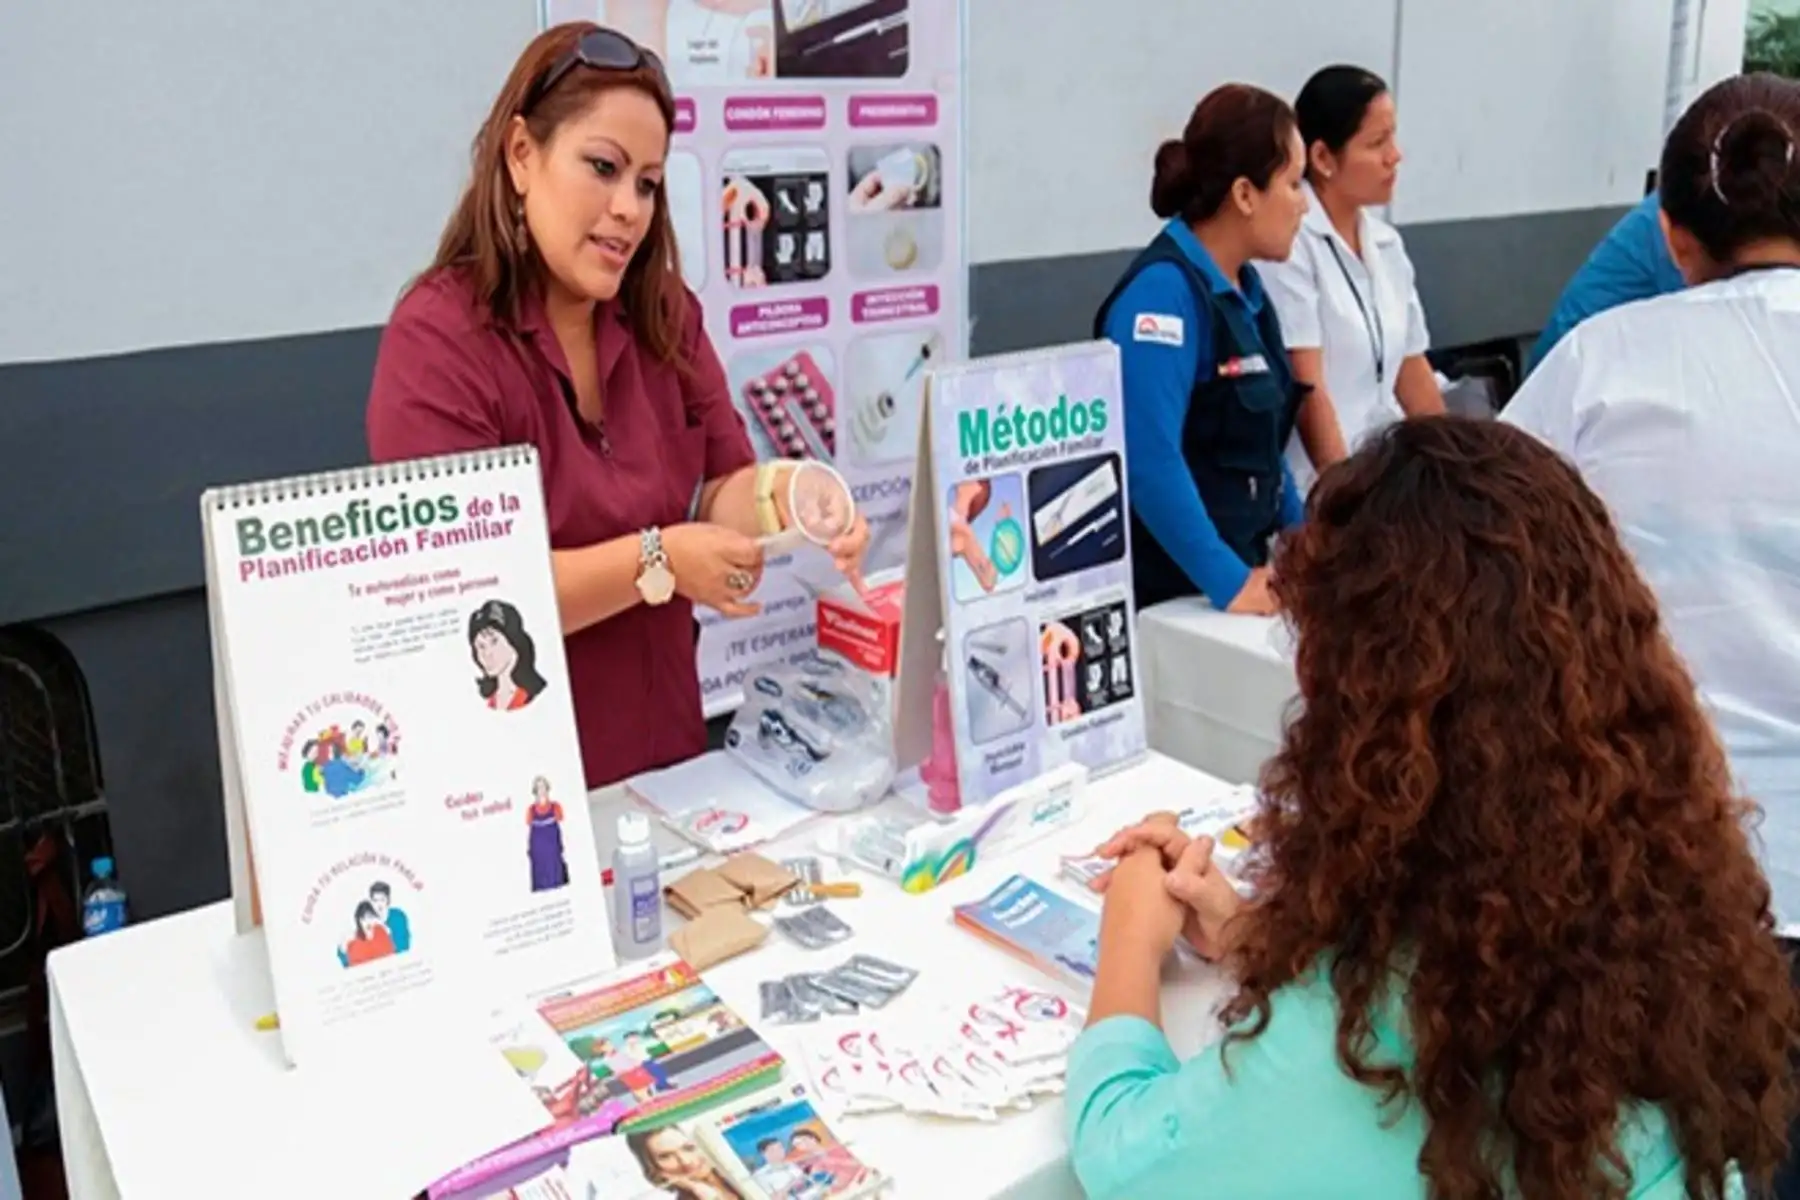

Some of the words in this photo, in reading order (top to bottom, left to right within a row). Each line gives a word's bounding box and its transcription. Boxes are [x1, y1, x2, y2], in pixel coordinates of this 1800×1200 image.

[958, 394, 1107, 457] Métodos
[964, 458, 980, 474] de
[983, 443, 1058, 470] Planificación
[1059, 436, 1103, 456] Familiar
[851, 475, 911, 500] CEPCIÓN
[235, 493, 459, 556] Beneficios
[466, 496, 494, 518] de
[499, 493, 521, 513] la
[239, 534, 409, 582] Planificación
[416, 519, 514, 551] Familiar
[751, 624, 816, 650] ESPERAM
